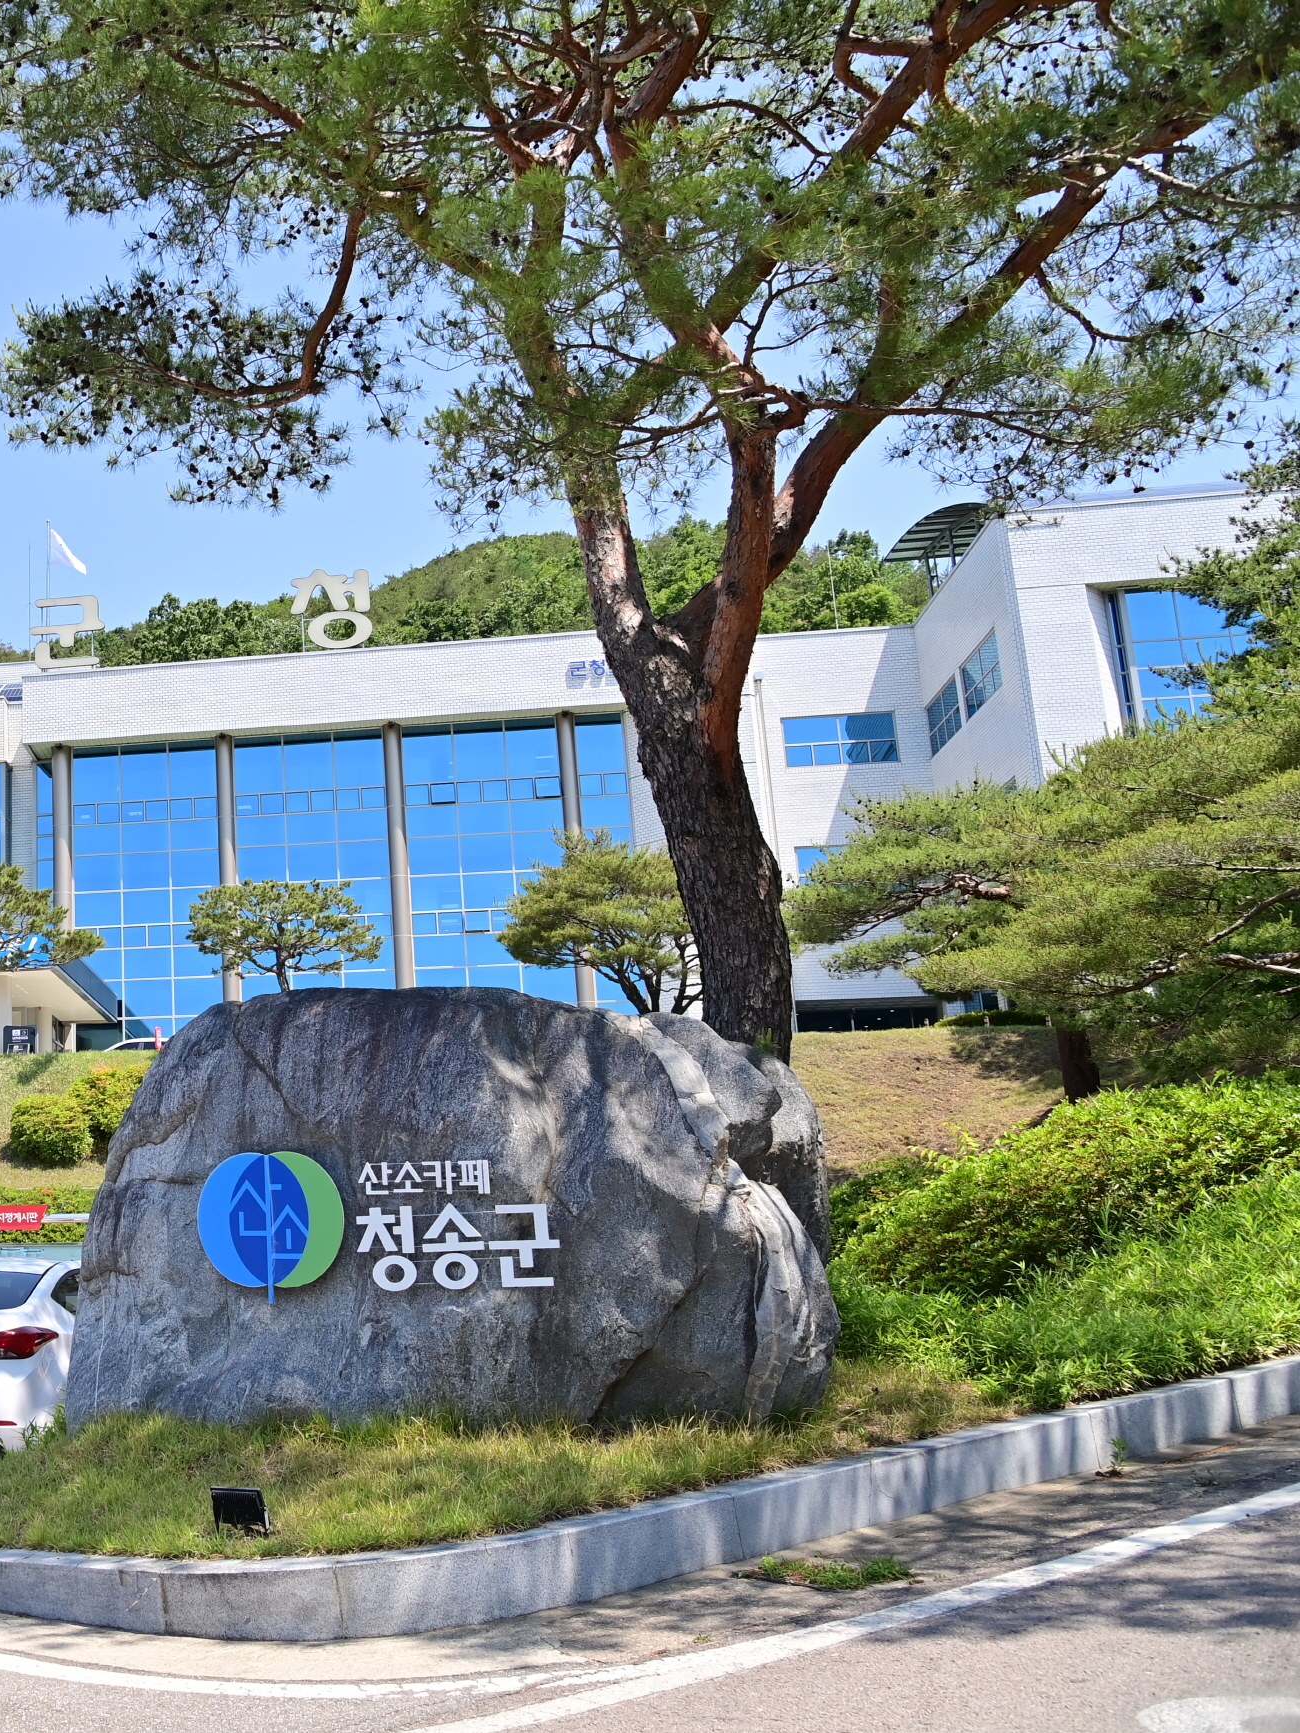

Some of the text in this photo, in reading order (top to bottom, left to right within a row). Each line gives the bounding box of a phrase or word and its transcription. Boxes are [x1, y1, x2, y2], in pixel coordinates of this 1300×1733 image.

[569, 660, 614, 677] 군청
[358, 1159, 491, 1195] 산소카페
[356, 1203, 560, 1291] 청송군
